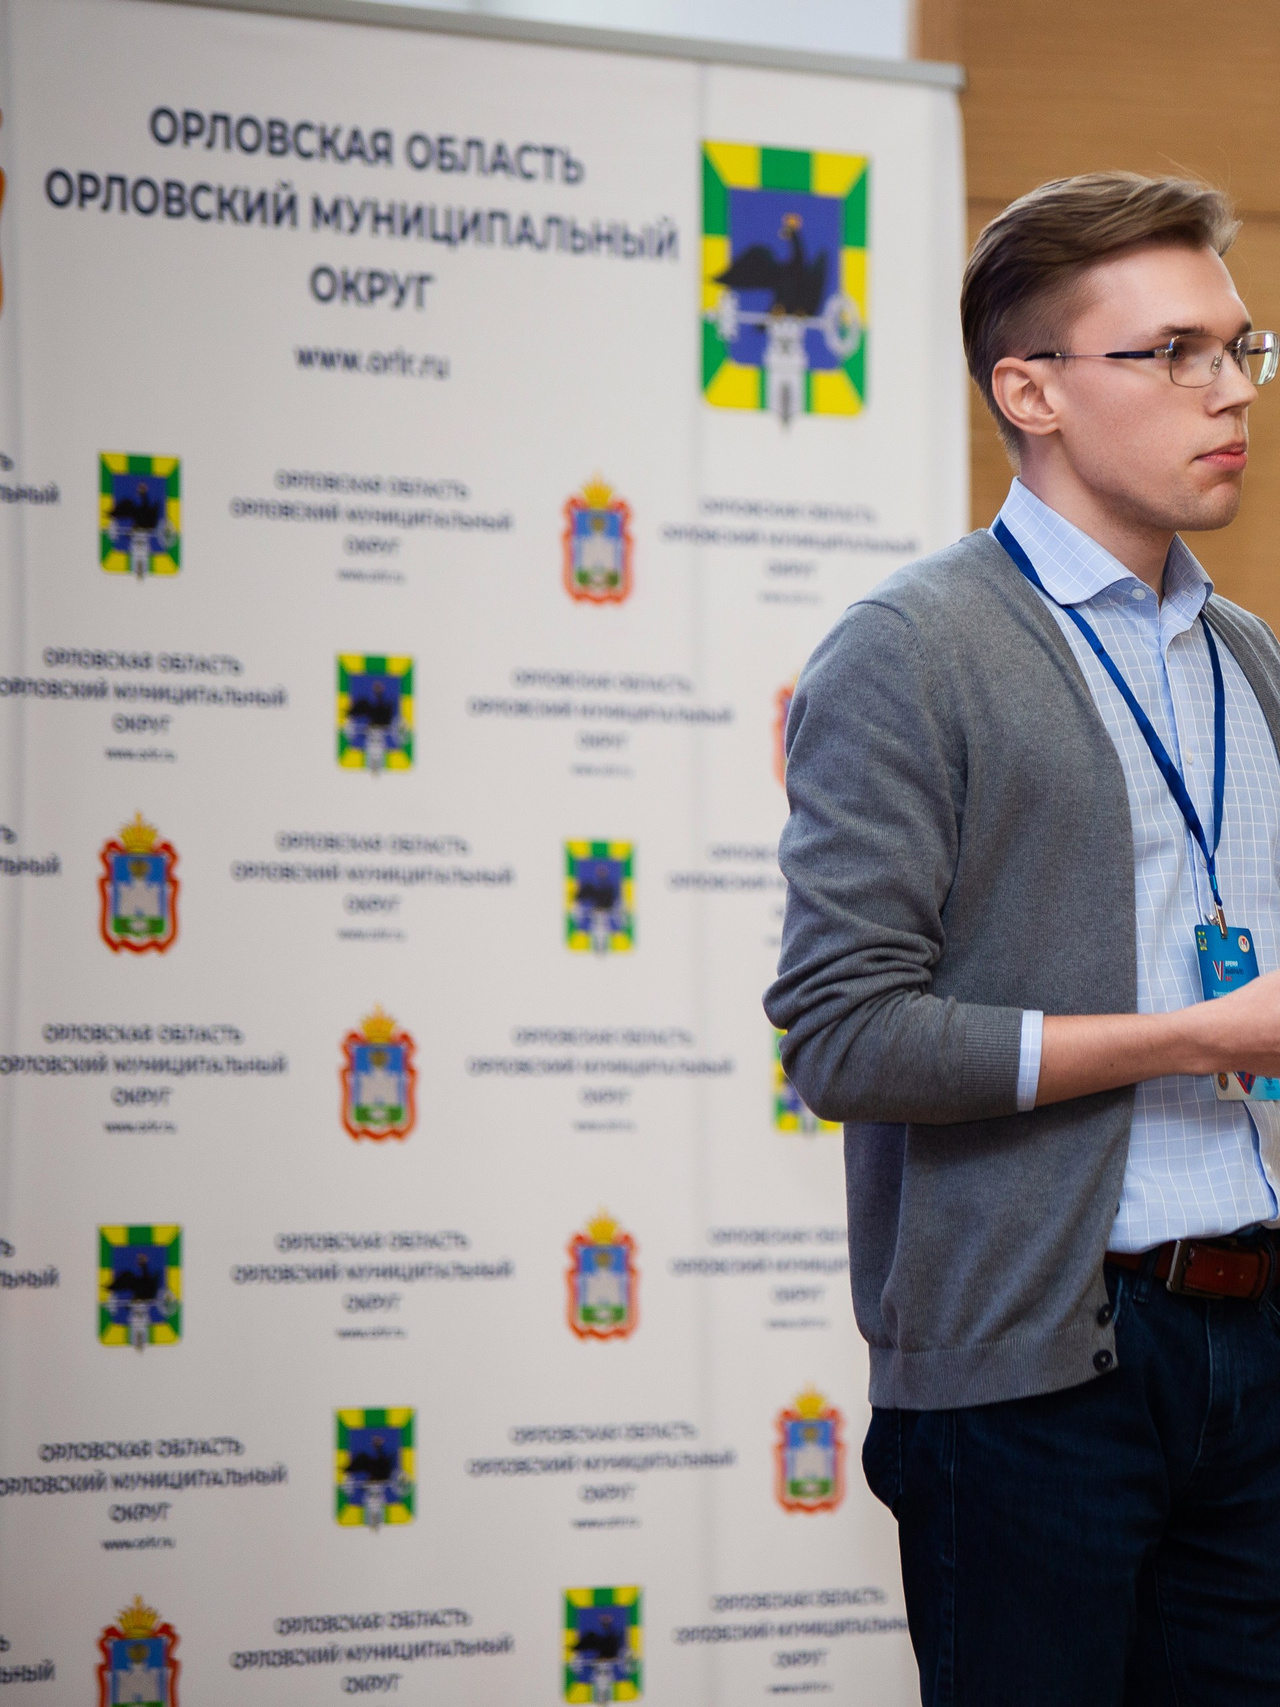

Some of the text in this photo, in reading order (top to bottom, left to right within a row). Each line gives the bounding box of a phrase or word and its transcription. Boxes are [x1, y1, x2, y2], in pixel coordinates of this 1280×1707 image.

[148, 105, 586, 187] ОРЛОВСКАЯ ОБЛАСТЬ
[43, 168, 680, 261] ОРЛОВСКИЙ МУНИЦИПАЛЬНЫЙ
[308, 264, 436, 310] ОКРУГ
